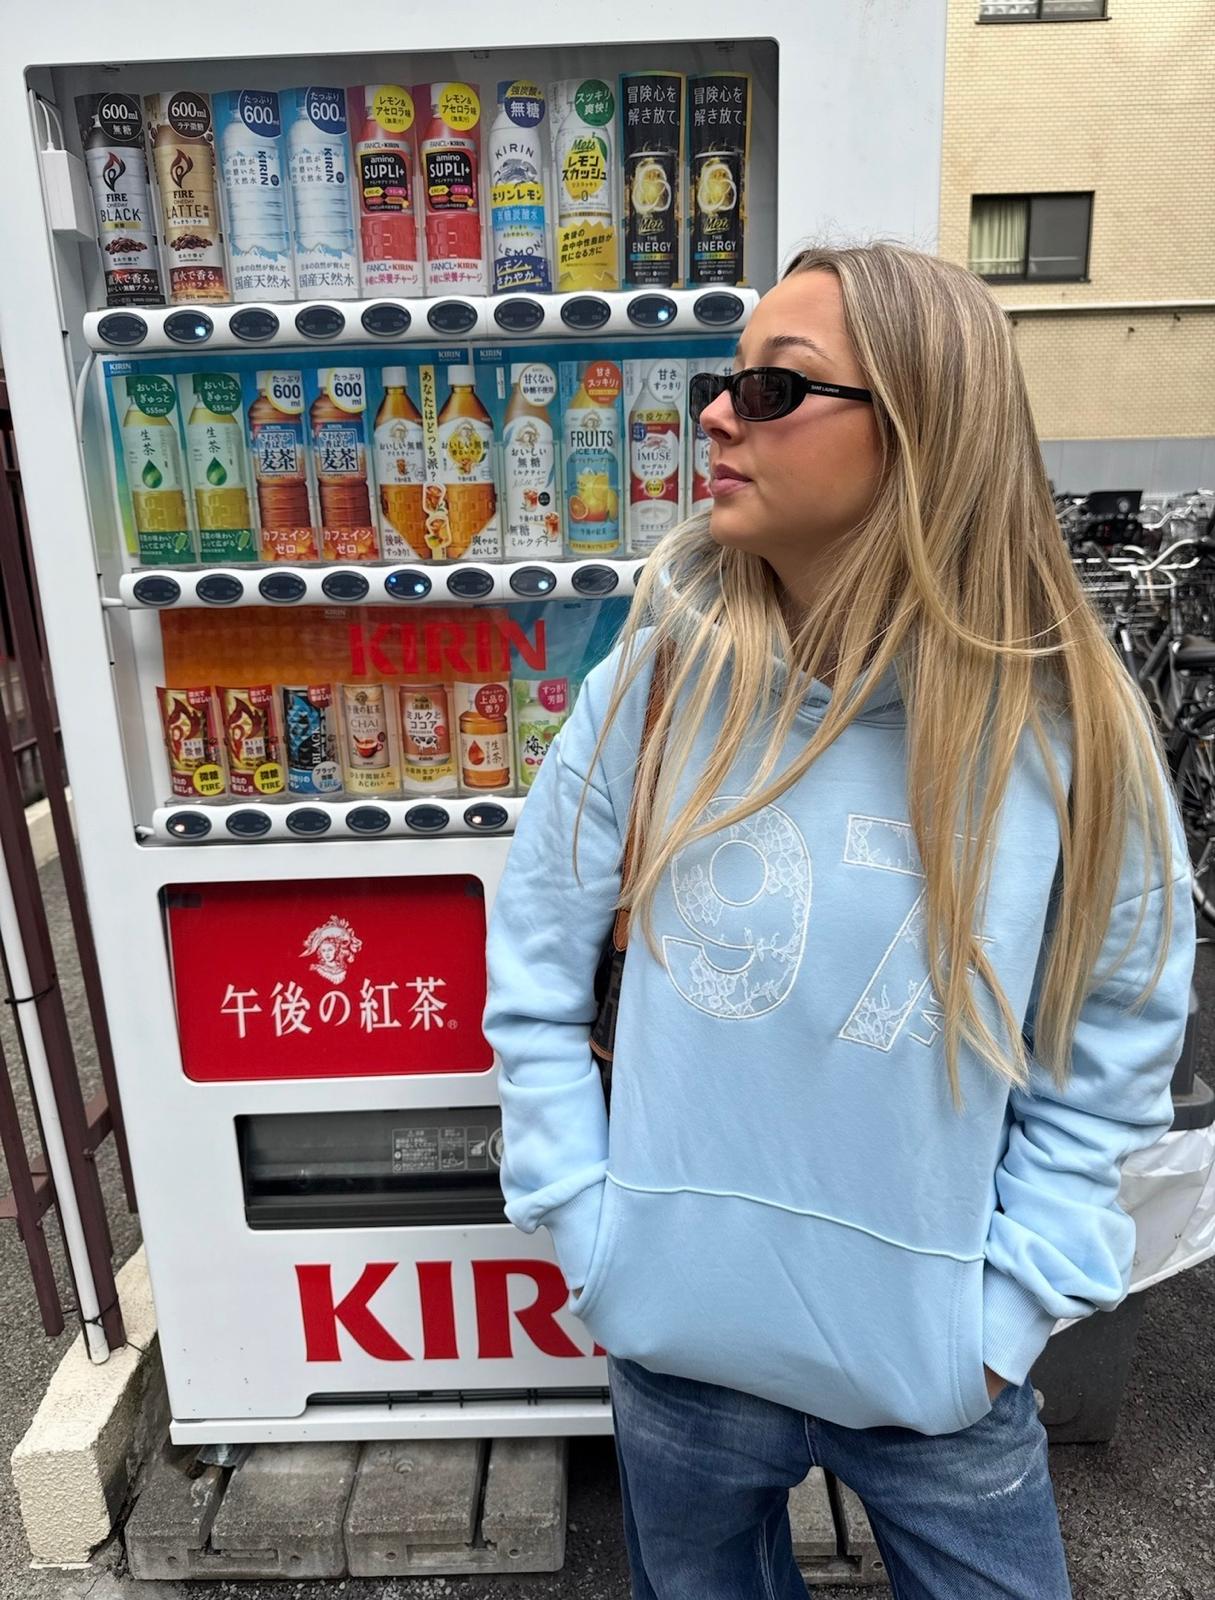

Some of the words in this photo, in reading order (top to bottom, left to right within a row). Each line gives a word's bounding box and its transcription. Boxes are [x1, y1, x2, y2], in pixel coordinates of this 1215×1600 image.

[243, 95, 273, 105] たっぷり
[310, 92, 339, 102] たっぷり
[445, 94, 472, 104] レモン&
[575, 88, 611, 105] スッキリ
[627, 84, 677, 105] 冒険心を
[694, 86, 743, 105] 冒険心を
[379, 96, 406, 107] レモン&
[102, 103, 139, 121] 600ml
[171, 101, 207, 118] 600ml
[376, 106, 411, 118] アセロラ味
[441, 104, 477, 116] アセロラ味
[510, 101, 540, 119] 無糖
[584, 102, 609, 116] 爽快!
[628, 108, 680, 126] 解き放て。
[694, 108, 746, 126] 解き放て。
[112, 124, 132, 136] 無糖
[495, 143, 535, 159] KIRIN
[232, 157, 255, 167] 自然が
[298, 156, 321, 165] 自然が
[370, 156, 394, 164] amino
[435, 154, 460, 162] amino
[568, 155, 600, 168] レモン
[258, 150, 269, 186] KIRIN
[324, 148, 334, 183] KIRIN
[429, 162, 470, 178] SUPLI+
[364, 165, 405, 180] SUPLI+
[561, 168, 608, 181] スカッシュ
[234, 176, 257, 185] 天然水
[300, 175, 323, 183] 天然水
[106, 193, 128, 202] FIRE
[173, 190, 195, 199] FIRE
[492, 189, 543, 202] キリンレモン
[100, 208, 142, 223] BLACK
[166, 204, 203, 220] LATTE
[562, 229, 585, 241] 食後の
[632, 241, 672, 253] ENERGY
[697, 240, 737, 252] ENERGY
[560, 245, 602, 263] 気になる方に
[366, 264, 389, 272] FANCL
[392, 264, 414, 272] KIRIN
[431, 262, 454, 271] FANCL
[457, 262, 478, 270] KIRIN
[496, 258, 530, 275] レモン、
[234, 274, 291, 290] 国産天然水
[299, 272, 354, 289] 国産天然水
[497, 271, 535, 288] さわやか
[333, 373, 361, 382] たっぷり
[595, 367, 611, 377] 甘さ
[657, 368, 678, 381] 甘さ
[272, 375, 300, 384] たっぷり
[524, 373, 553, 384] 甘くない
[587, 378, 619, 388] スッキリ!
[136, 383, 172, 393] おいしさ、
[204, 381, 238, 390] おいしさ、
[334, 382, 362, 398] 600
[654, 381, 682, 391] すっきり
[206, 391, 236, 402] ぎゅっと
[273, 384, 301, 400] 600
[139, 393, 170, 404] ぎゅっと
[290, 399, 300, 408] ml
[351, 398, 362, 406] ml
[422, 370, 439, 483] あなたはどっち派?
[140, 429, 156, 456] 生茶
[206, 426, 221, 454] 生茶
[570, 430, 614, 448] FRUITS
[379, 441, 423, 451] おいしい無糖
[441, 441, 491, 451] おいしい無糖
[511, 447, 547, 456] おいしい
[594, 447, 609, 455] TEA
[262, 449, 295, 471] 麦茶
[323, 448, 356, 470] 麦茶
[517, 456, 541, 468] 無糖
[263, 530, 311, 541] カフェイン
[324, 529, 372, 540] カフェイン
[509, 524, 531, 537] 無糖
[384, 535, 404, 547] 後味
[472, 535, 499, 546] 爽やかな
[511, 538, 557, 547] ミルクティー
[275, 543, 296, 554] ゼロ
[336, 542, 357, 554] ゼロ
[472, 545, 499, 556] おいしさ
[348, 619, 547, 676] KIRIN
[542, 684, 567, 696] すっきり
[479, 696, 504, 706] 上品な
[485, 704, 501, 714] 香り
[406, 711, 441, 721] ミルクと
[350, 718, 379, 728] CHAI
[410, 720, 437, 729] ココア
[312, 727, 322, 764] BLACK
[491, 740, 503, 764] 生茶
[199, 770, 219, 782] 微糖
[260, 768, 279, 781] 微糖
[315, 767, 337, 775] ブラック
[200, 782, 222, 792] FIRE
[261, 781, 281, 790] FIRE
[662, 795, 996, 1054] 97
[220, 976, 448, 1040] 午後の紅茶
[294, 1259, 607, 1364] KIR
